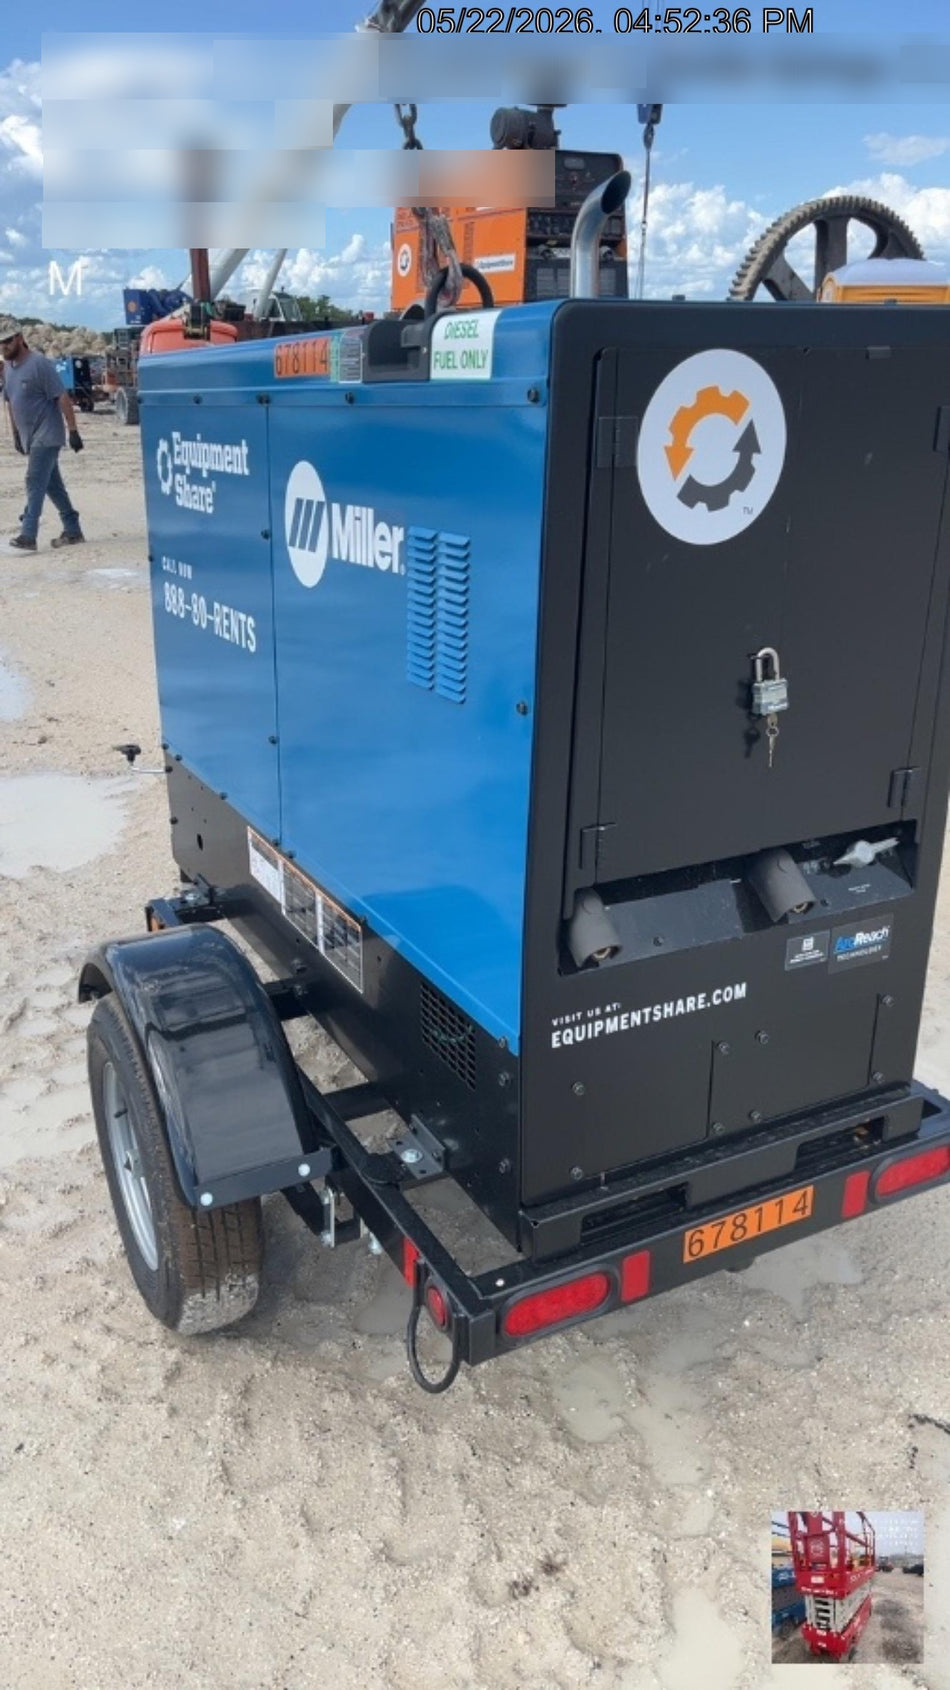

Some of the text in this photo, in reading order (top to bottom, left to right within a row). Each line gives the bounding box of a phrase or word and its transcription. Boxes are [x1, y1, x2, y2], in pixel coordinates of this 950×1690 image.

[444, 319, 480, 340] DIESEL
[276, 340, 328, 375] 678114
[433, 348, 489, 370] FUEL ONLY
[172, 431, 250, 478] Equipment
[331, 502, 405, 574] Miller
[162, 555, 177, 574] CALL
[164, 581, 257, 653] 888-80-RENTS
[551, 981, 747, 1049] EQUIPMENTSHARE.COM
[551, 1011, 583, 1027] VISIT
[587, 1007, 602, 1018] US
[688, 1190, 809, 1258] 678114
